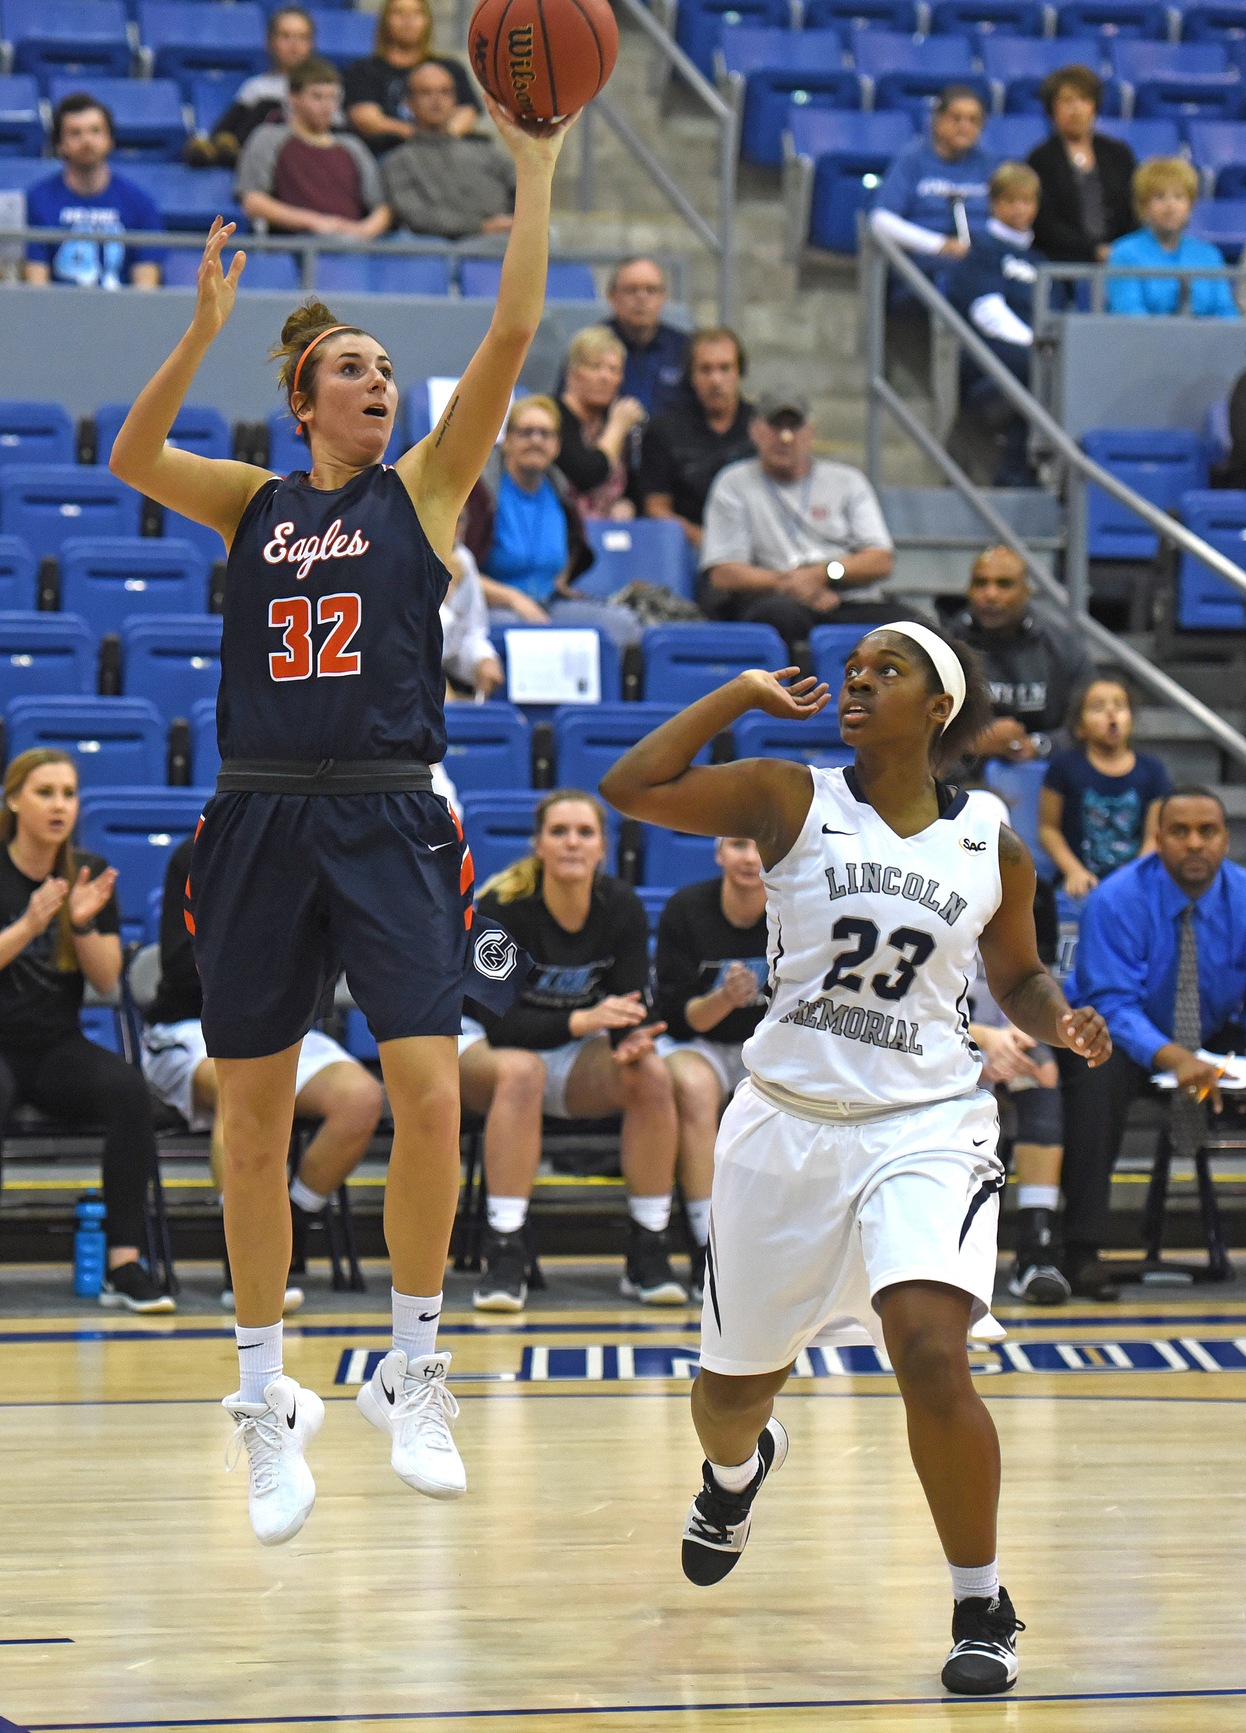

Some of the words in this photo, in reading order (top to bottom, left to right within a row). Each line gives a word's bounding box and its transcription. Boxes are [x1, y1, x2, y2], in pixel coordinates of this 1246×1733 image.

[263, 518, 370, 580] Eagles
[268, 592, 362, 682] 32
[963, 838, 987, 852] SAC
[825, 862, 968, 926] LINCOLN
[821, 914, 937, 1000] 23
[779, 997, 923, 1056] MEMORIAL
